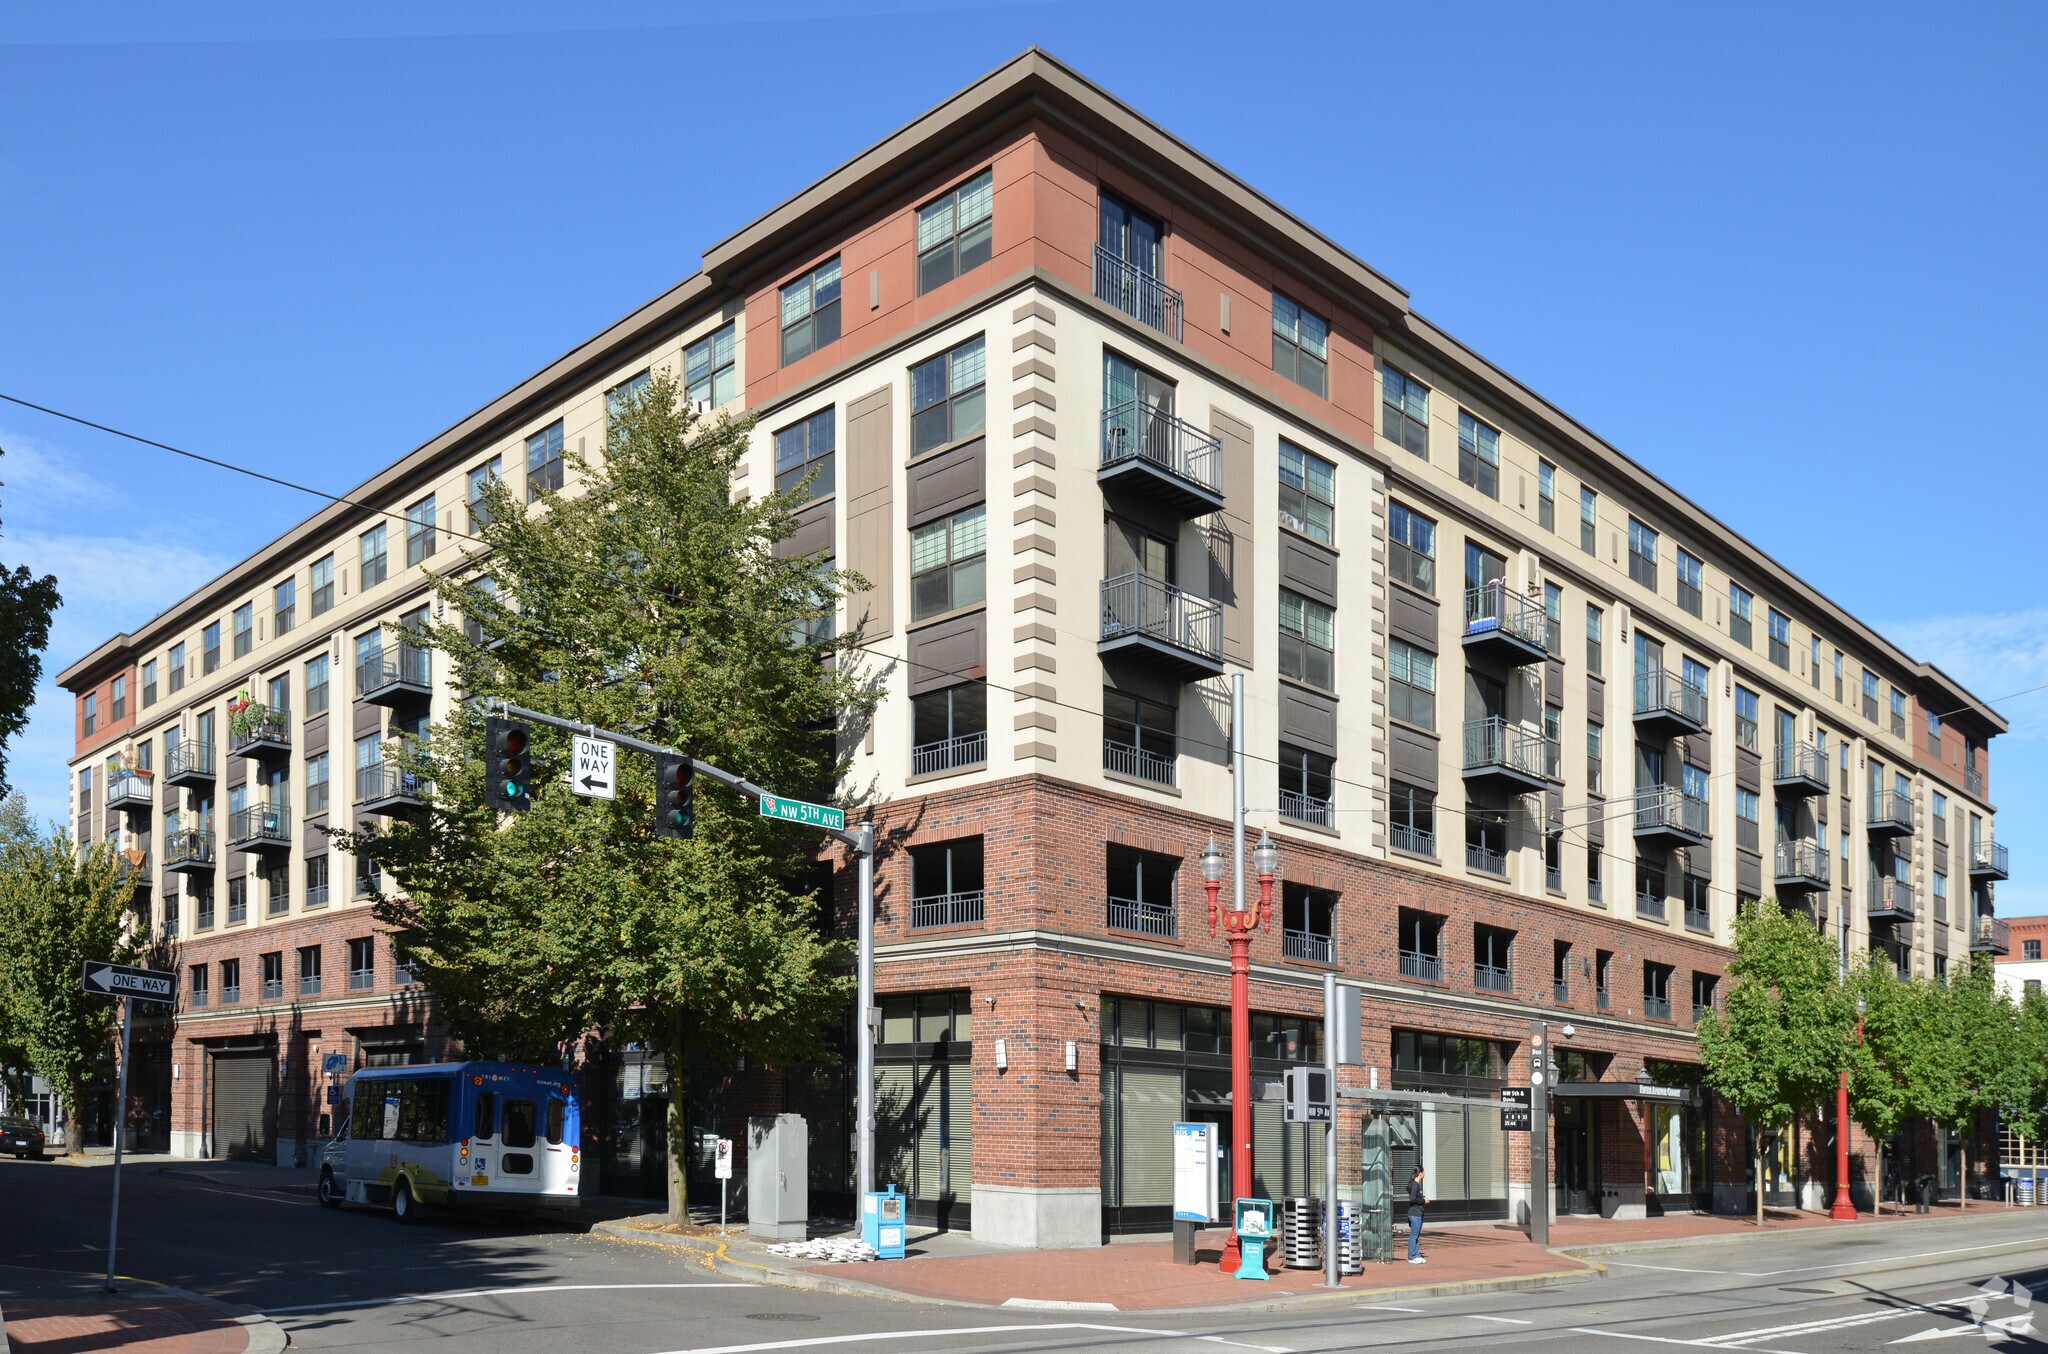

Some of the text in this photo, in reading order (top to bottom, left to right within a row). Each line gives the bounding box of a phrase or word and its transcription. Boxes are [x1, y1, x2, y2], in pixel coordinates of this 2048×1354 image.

[581, 742, 608, 758] ONE
[580, 757, 609, 773] WAY
[781, 804, 840, 827] NW 5TH AVE
[113, 974, 167, 992] ONE WAY
[1308, 1107, 1317, 1117] NW
